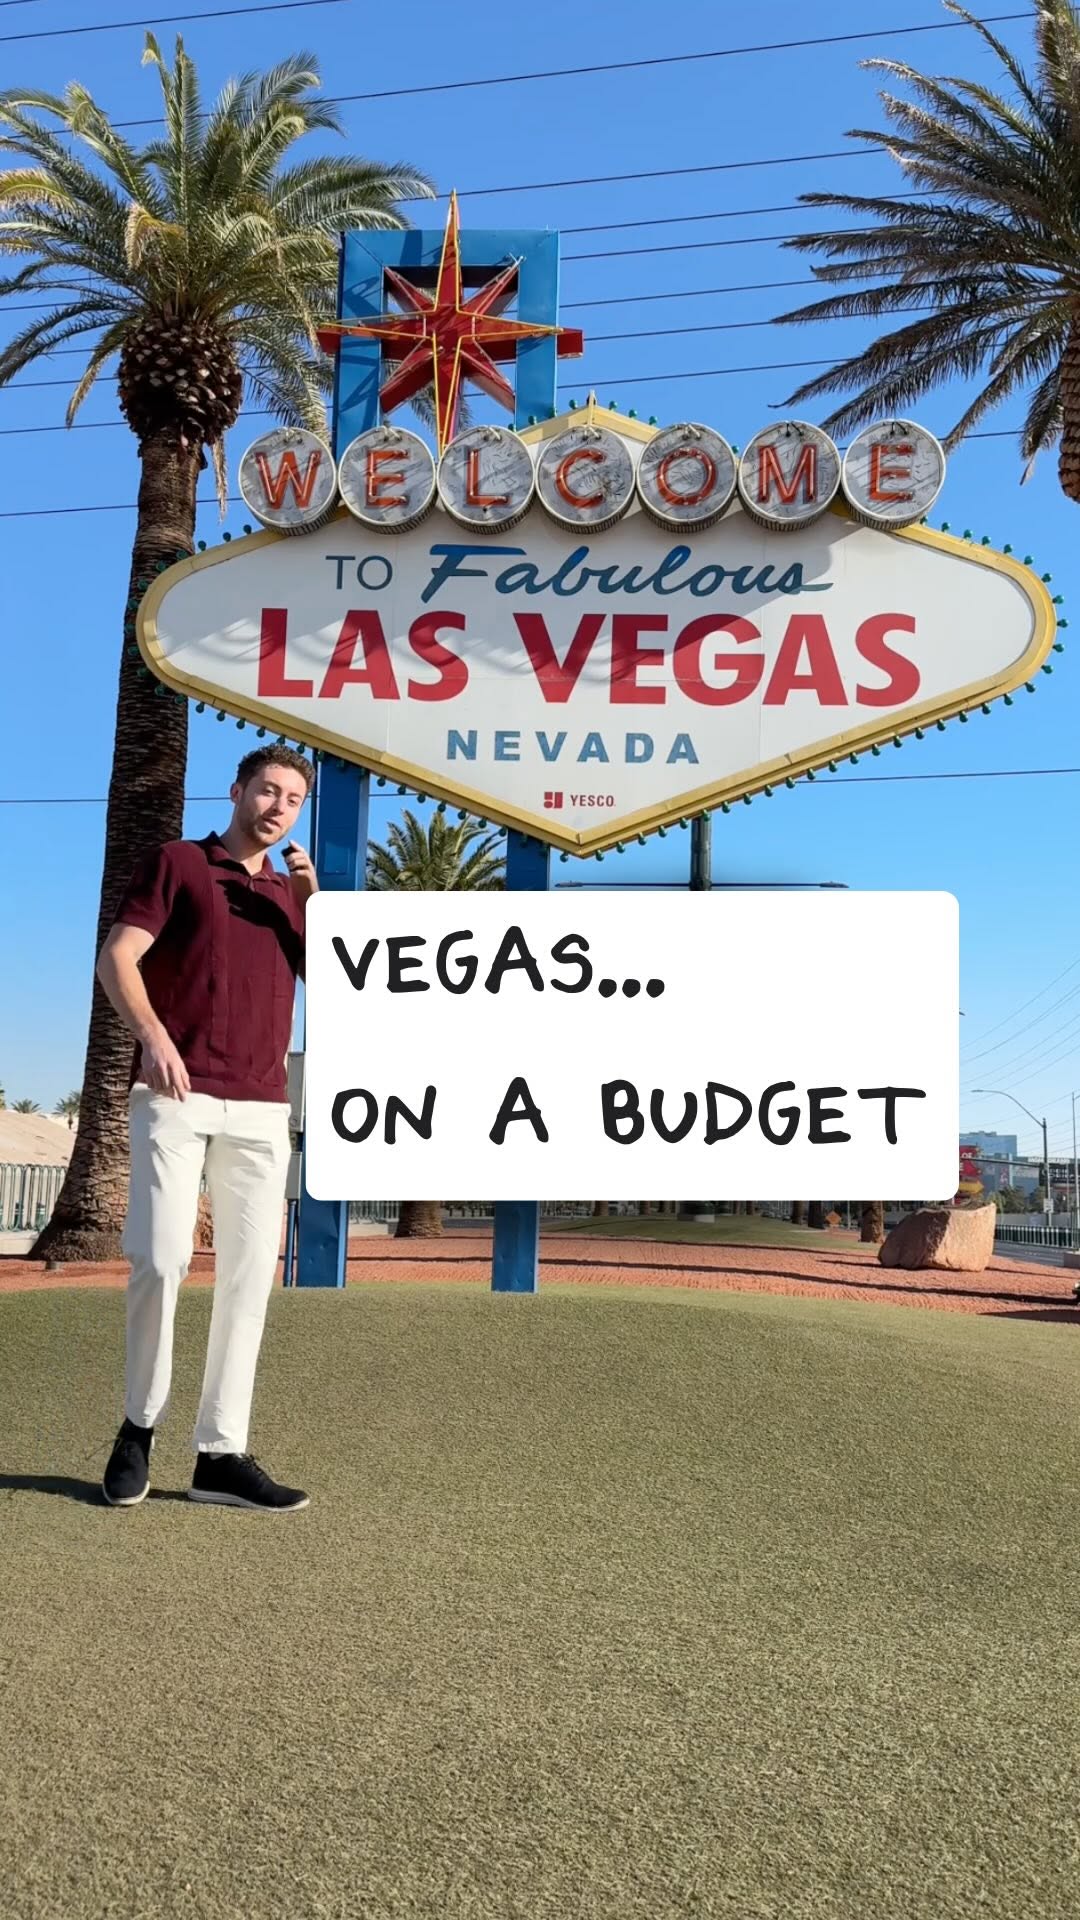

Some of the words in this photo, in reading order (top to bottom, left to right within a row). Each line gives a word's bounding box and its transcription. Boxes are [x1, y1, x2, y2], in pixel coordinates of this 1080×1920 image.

[253, 443, 914, 511] WELCOME
[325, 555, 393, 591] TO
[421, 543, 833, 604] Fabulous
[257, 608, 469, 702] LAS
[513, 613, 920, 707] VEGAS
[446, 729, 700, 764] NEVADA
[569, 794, 615, 808] YESCO
